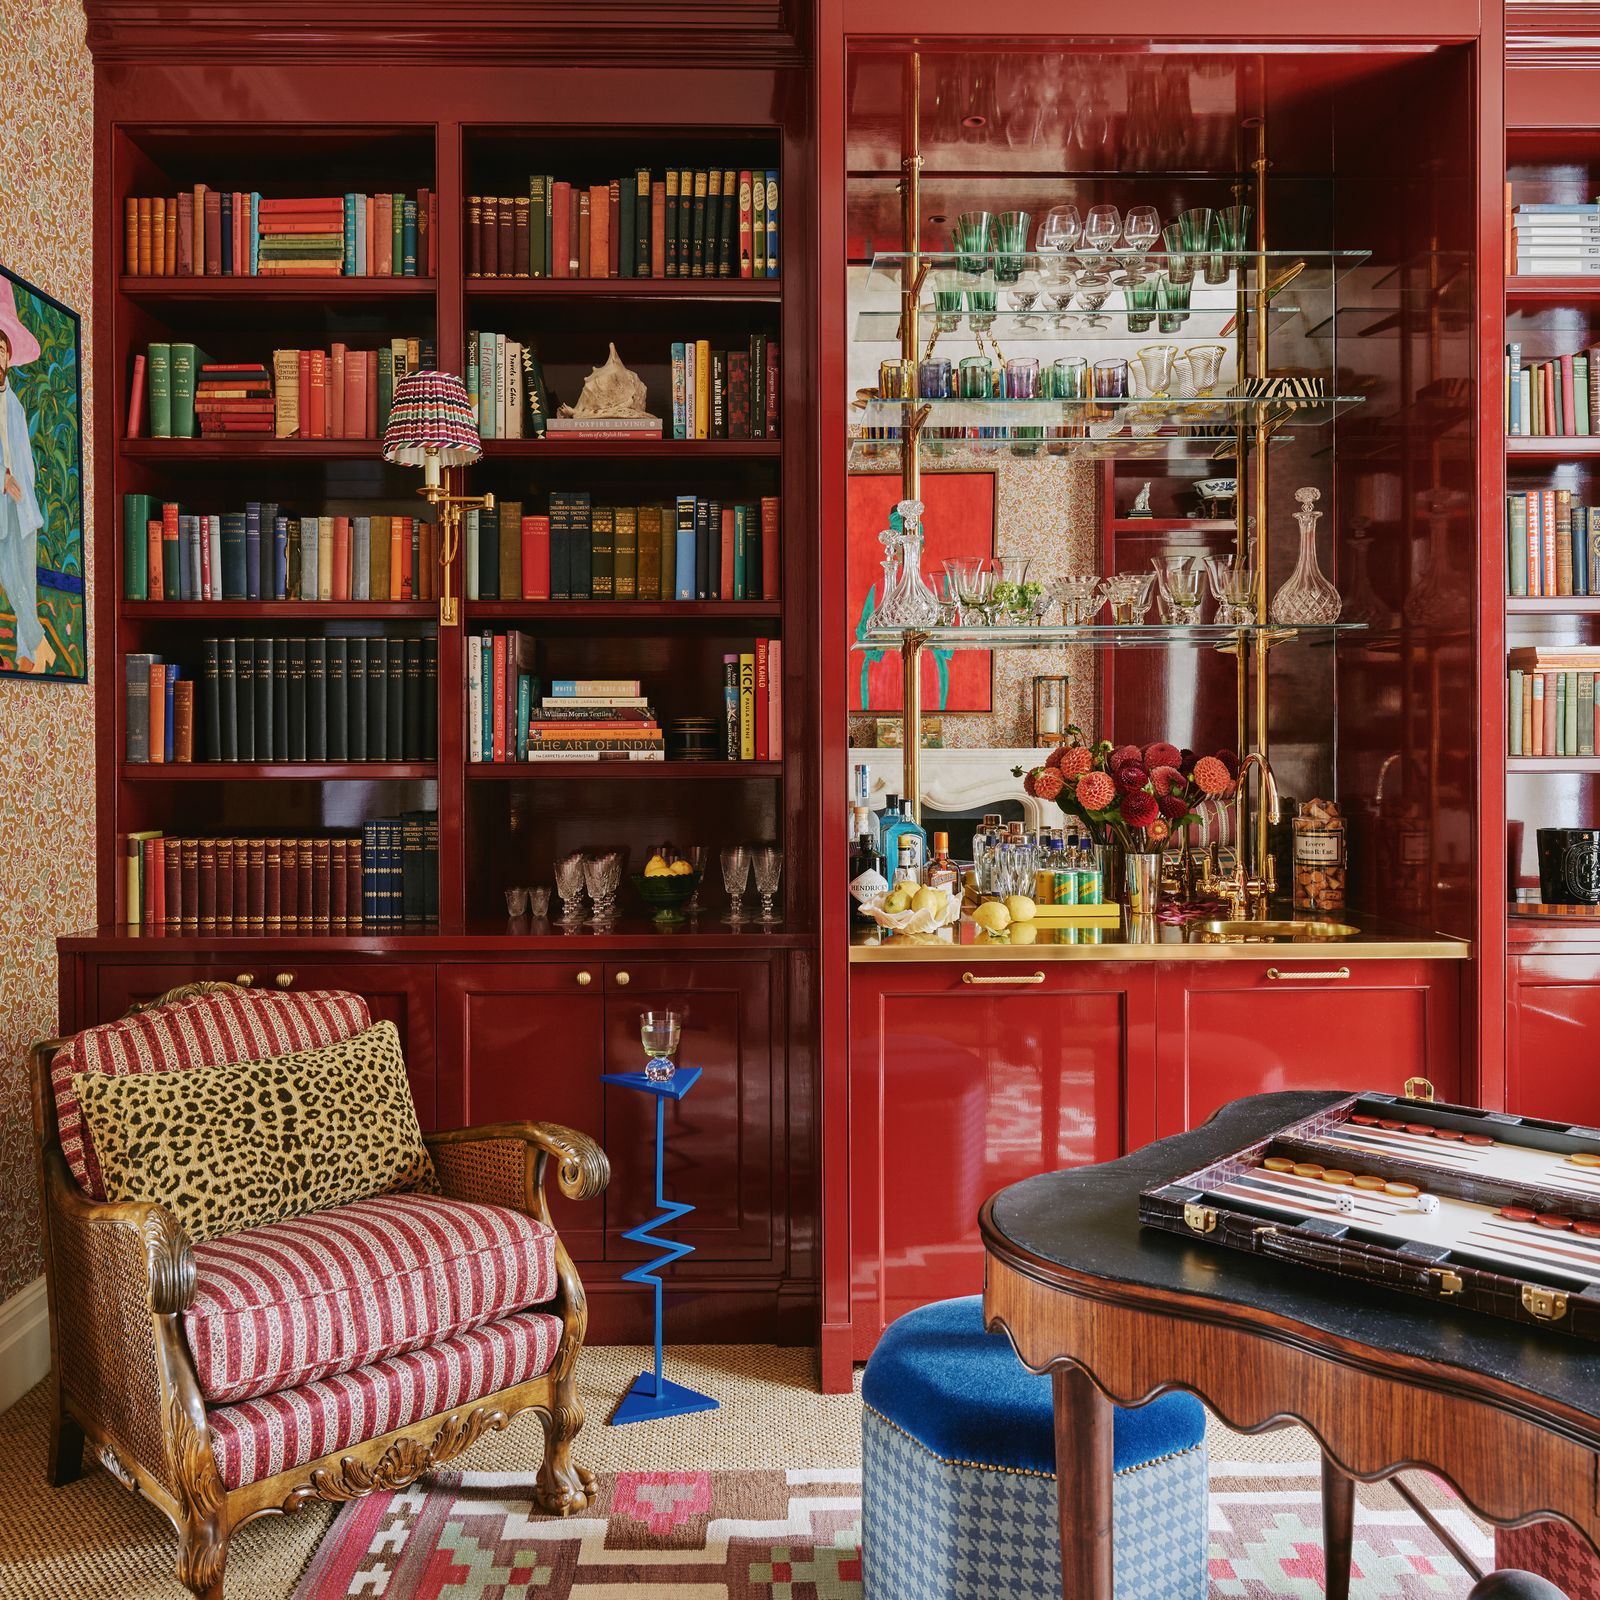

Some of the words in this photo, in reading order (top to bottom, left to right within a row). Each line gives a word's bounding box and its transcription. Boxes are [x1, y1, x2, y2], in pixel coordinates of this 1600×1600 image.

[468, 341, 476, 378] Spectrum
[768, 368, 778, 392] Georgette
[574, 420, 610, 429] FOXFIRE
[615, 420, 646, 429] LIVING
[1529, 495, 1538, 513] THE
[1545, 495, 1554, 513] THE
[1529, 515, 1538, 534] KEY
[1545, 515, 1554, 534] KEY
[1529, 536, 1538, 558] MAN
[1545, 536, 1554, 558] MAN
[742, 664, 752, 695] KICK
[534, 741, 561, 750] THE
[565, 741, 591, 750] ART
[596, 741, 613, 750] OF
[617, 741, 657, 750] INDIA
